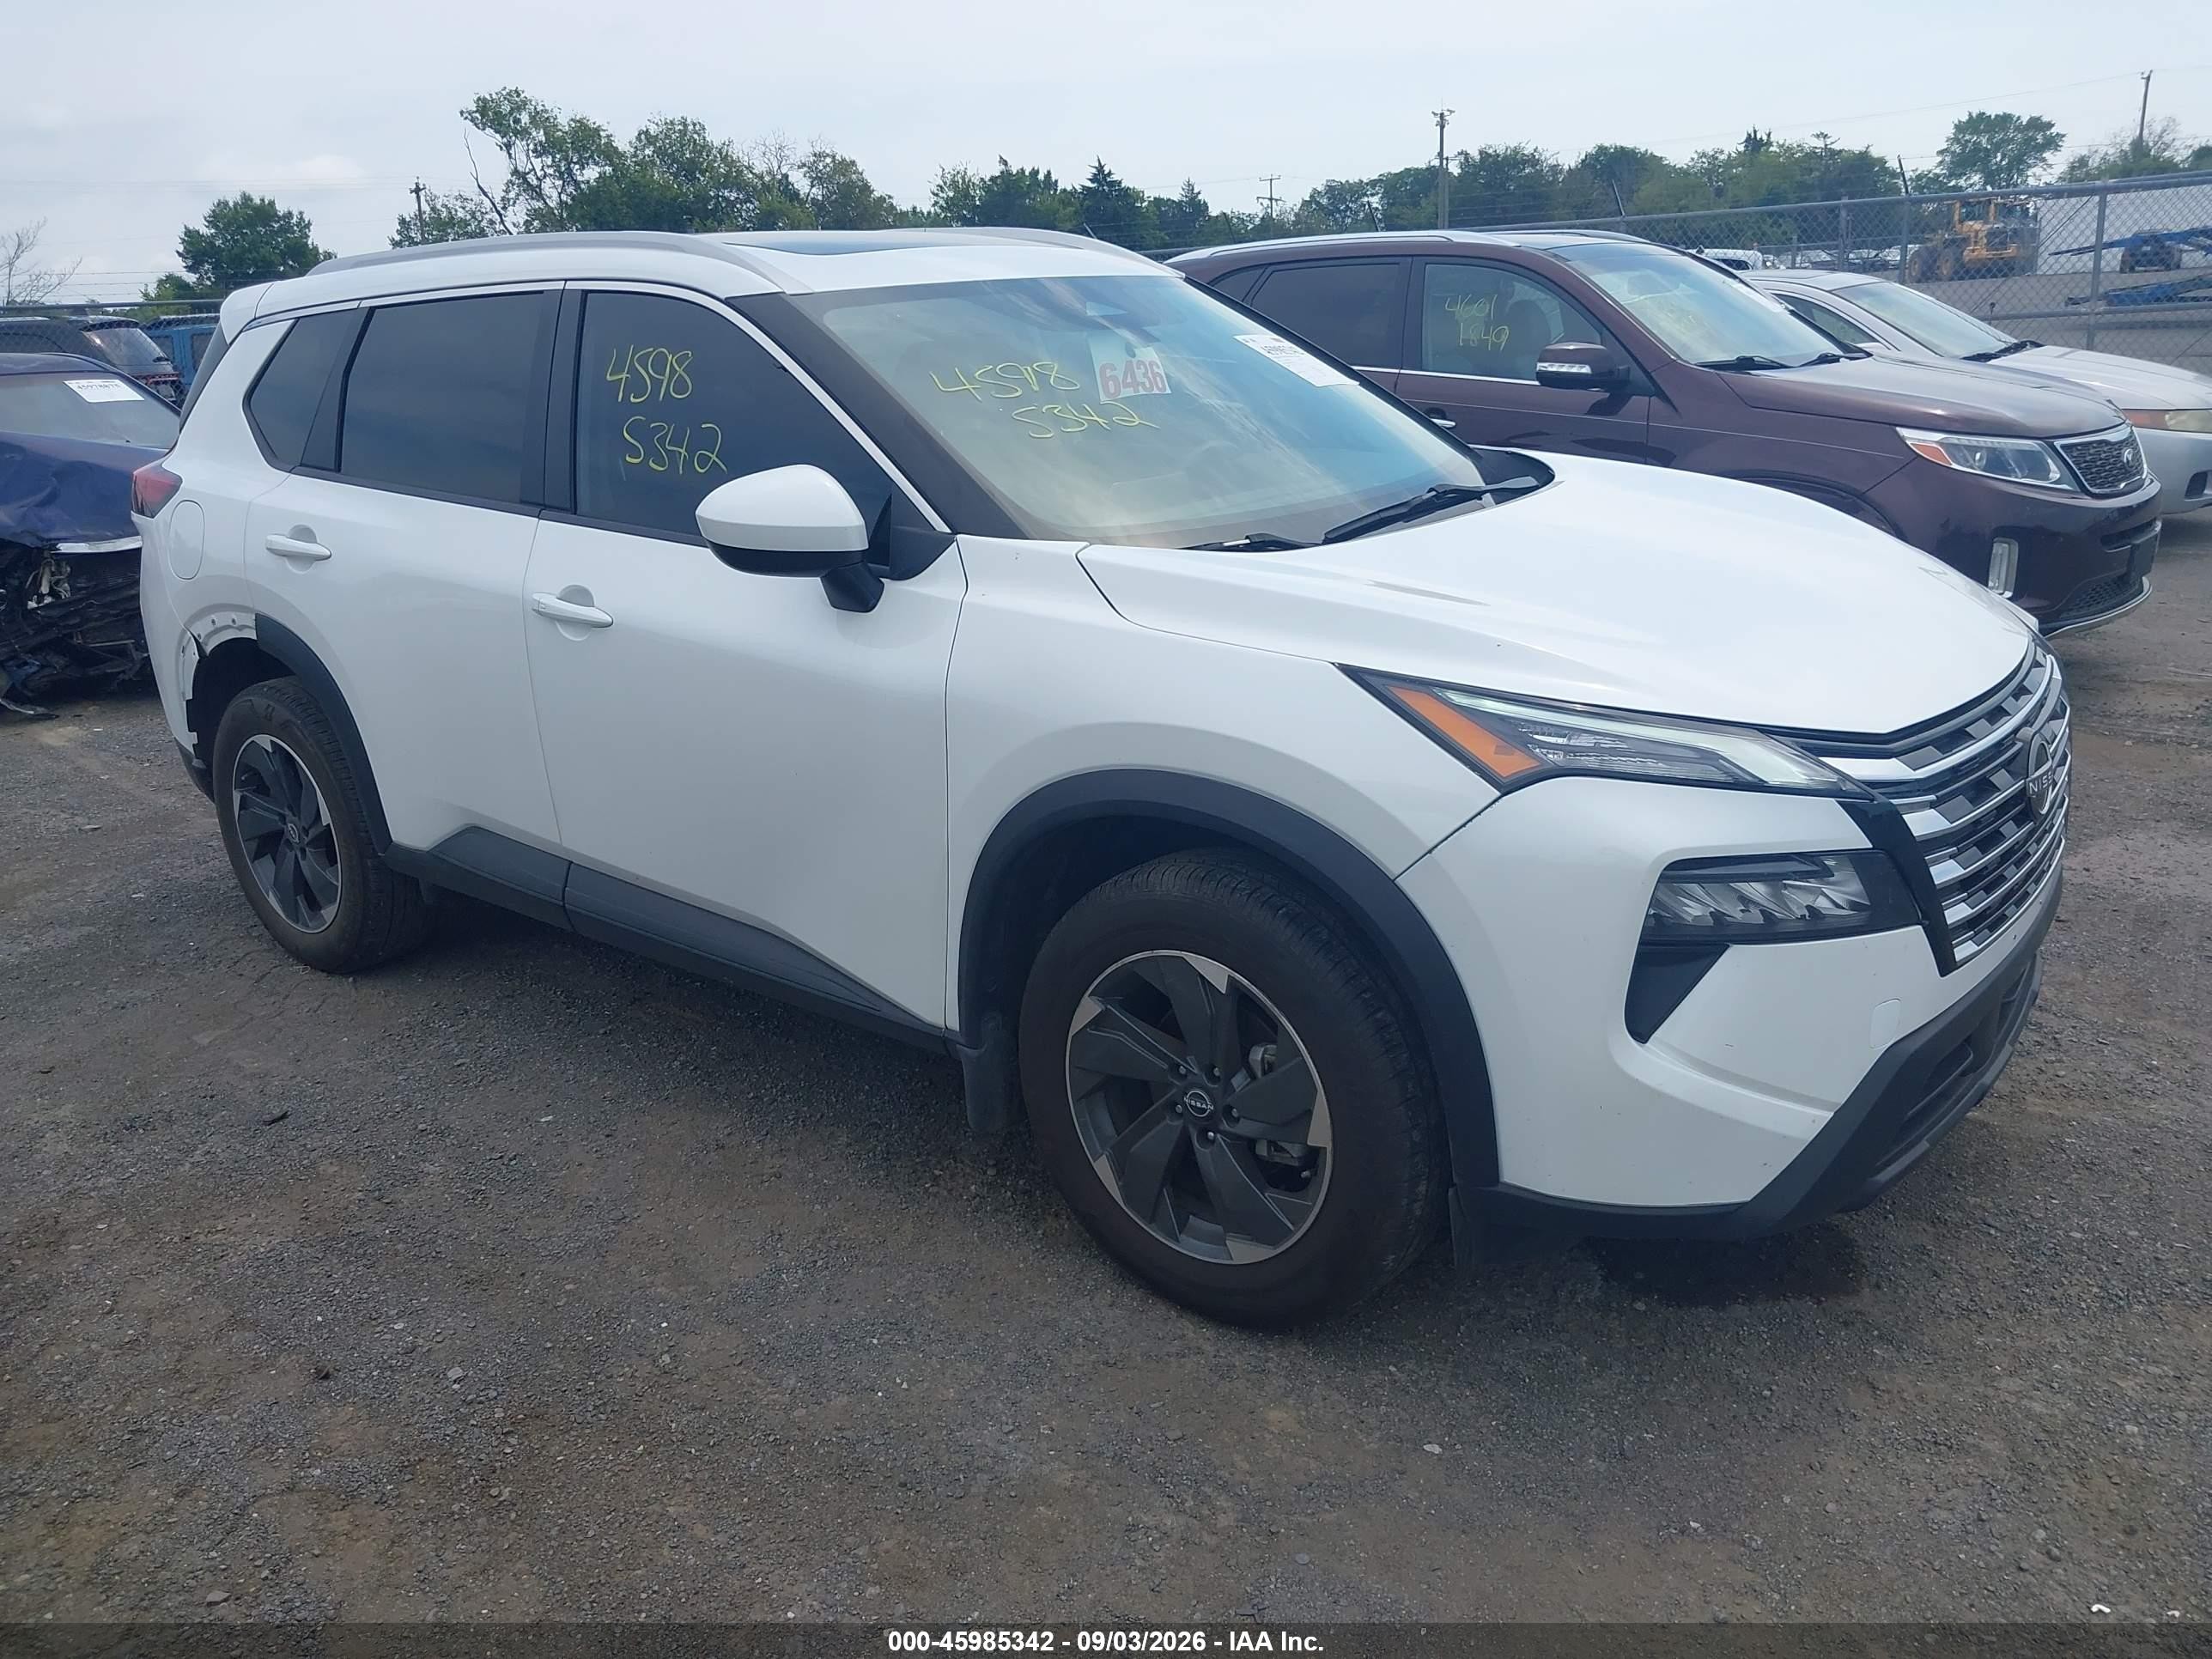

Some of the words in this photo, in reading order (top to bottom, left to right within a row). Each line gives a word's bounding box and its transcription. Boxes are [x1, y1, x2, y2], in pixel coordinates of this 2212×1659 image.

[1444, 294, 1498, 320] 4601
[1459, 322, 1510, 351] 1849
[605, 343, 694, 404] 4598
[928, 361, 1081, 401] 4598
[1098, 359, 1167, 399] 6436
[1011, 400, 1161, 439] 5342
[623, 416, 728, 476] 5342
[1183, 1097, 1213, 1111] NISSAN
